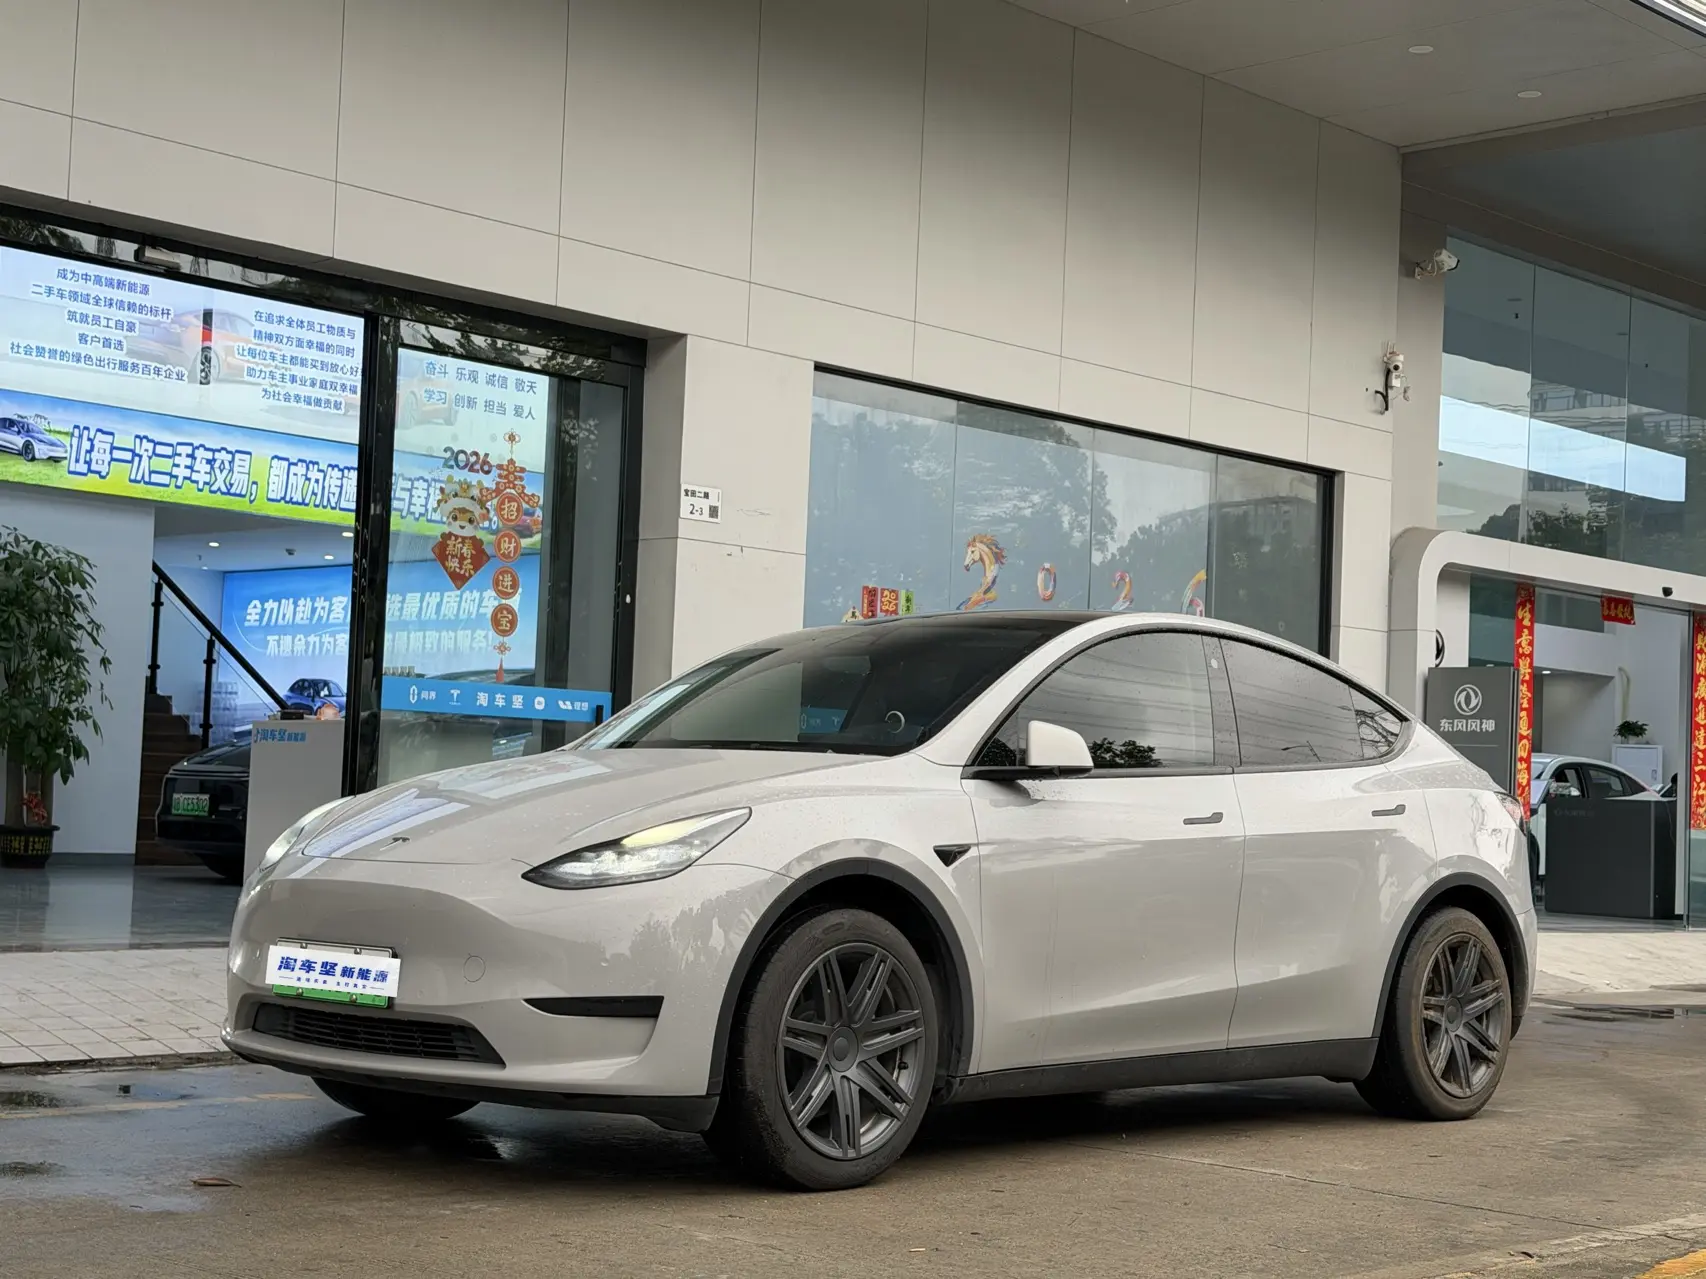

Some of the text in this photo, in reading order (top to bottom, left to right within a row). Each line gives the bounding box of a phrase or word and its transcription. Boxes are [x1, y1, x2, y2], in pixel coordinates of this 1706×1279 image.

[56, 268, 150, 296] 成为中高端新能源
[31, 283, 172, 321] 二手车领域全球信赖的标杆
[66, 309, 137, 333] 筑就员工自豪
[254, 310, 356, 340] 在追求全体员工物质与
[77, 333, 125, 351] 客户首选
[253, 329, 355, 358] 精神双方面幸福的同时
[10, 341, 186, 382] 社会赞誉的绿色出行服务百年企业
[236, 345, 362, 377] 让每位车主都能买到放心好
[246, 366, 358, 395] 助力车主事业家庭双幸福
[425, 360, 538, 395] 奋斗 乐观 诚信 敬天
[262, 387, 342, 411] 为社会幸福做贡献
[424, 388, 536, 420] 学习 创新 担当 爱人
[442, 446, 493, 475] 2026
[446, 536, 476, 558] 新春
[445, 555, 475, 577] 快乐
[244, 596, 350, 627] 全力以赴为客
[476, 691, 524, 709] 淘车坚
[1440, 718, 1495, 732] 东风风神
[277, 956, 389, 983] 淘车坚新能源
